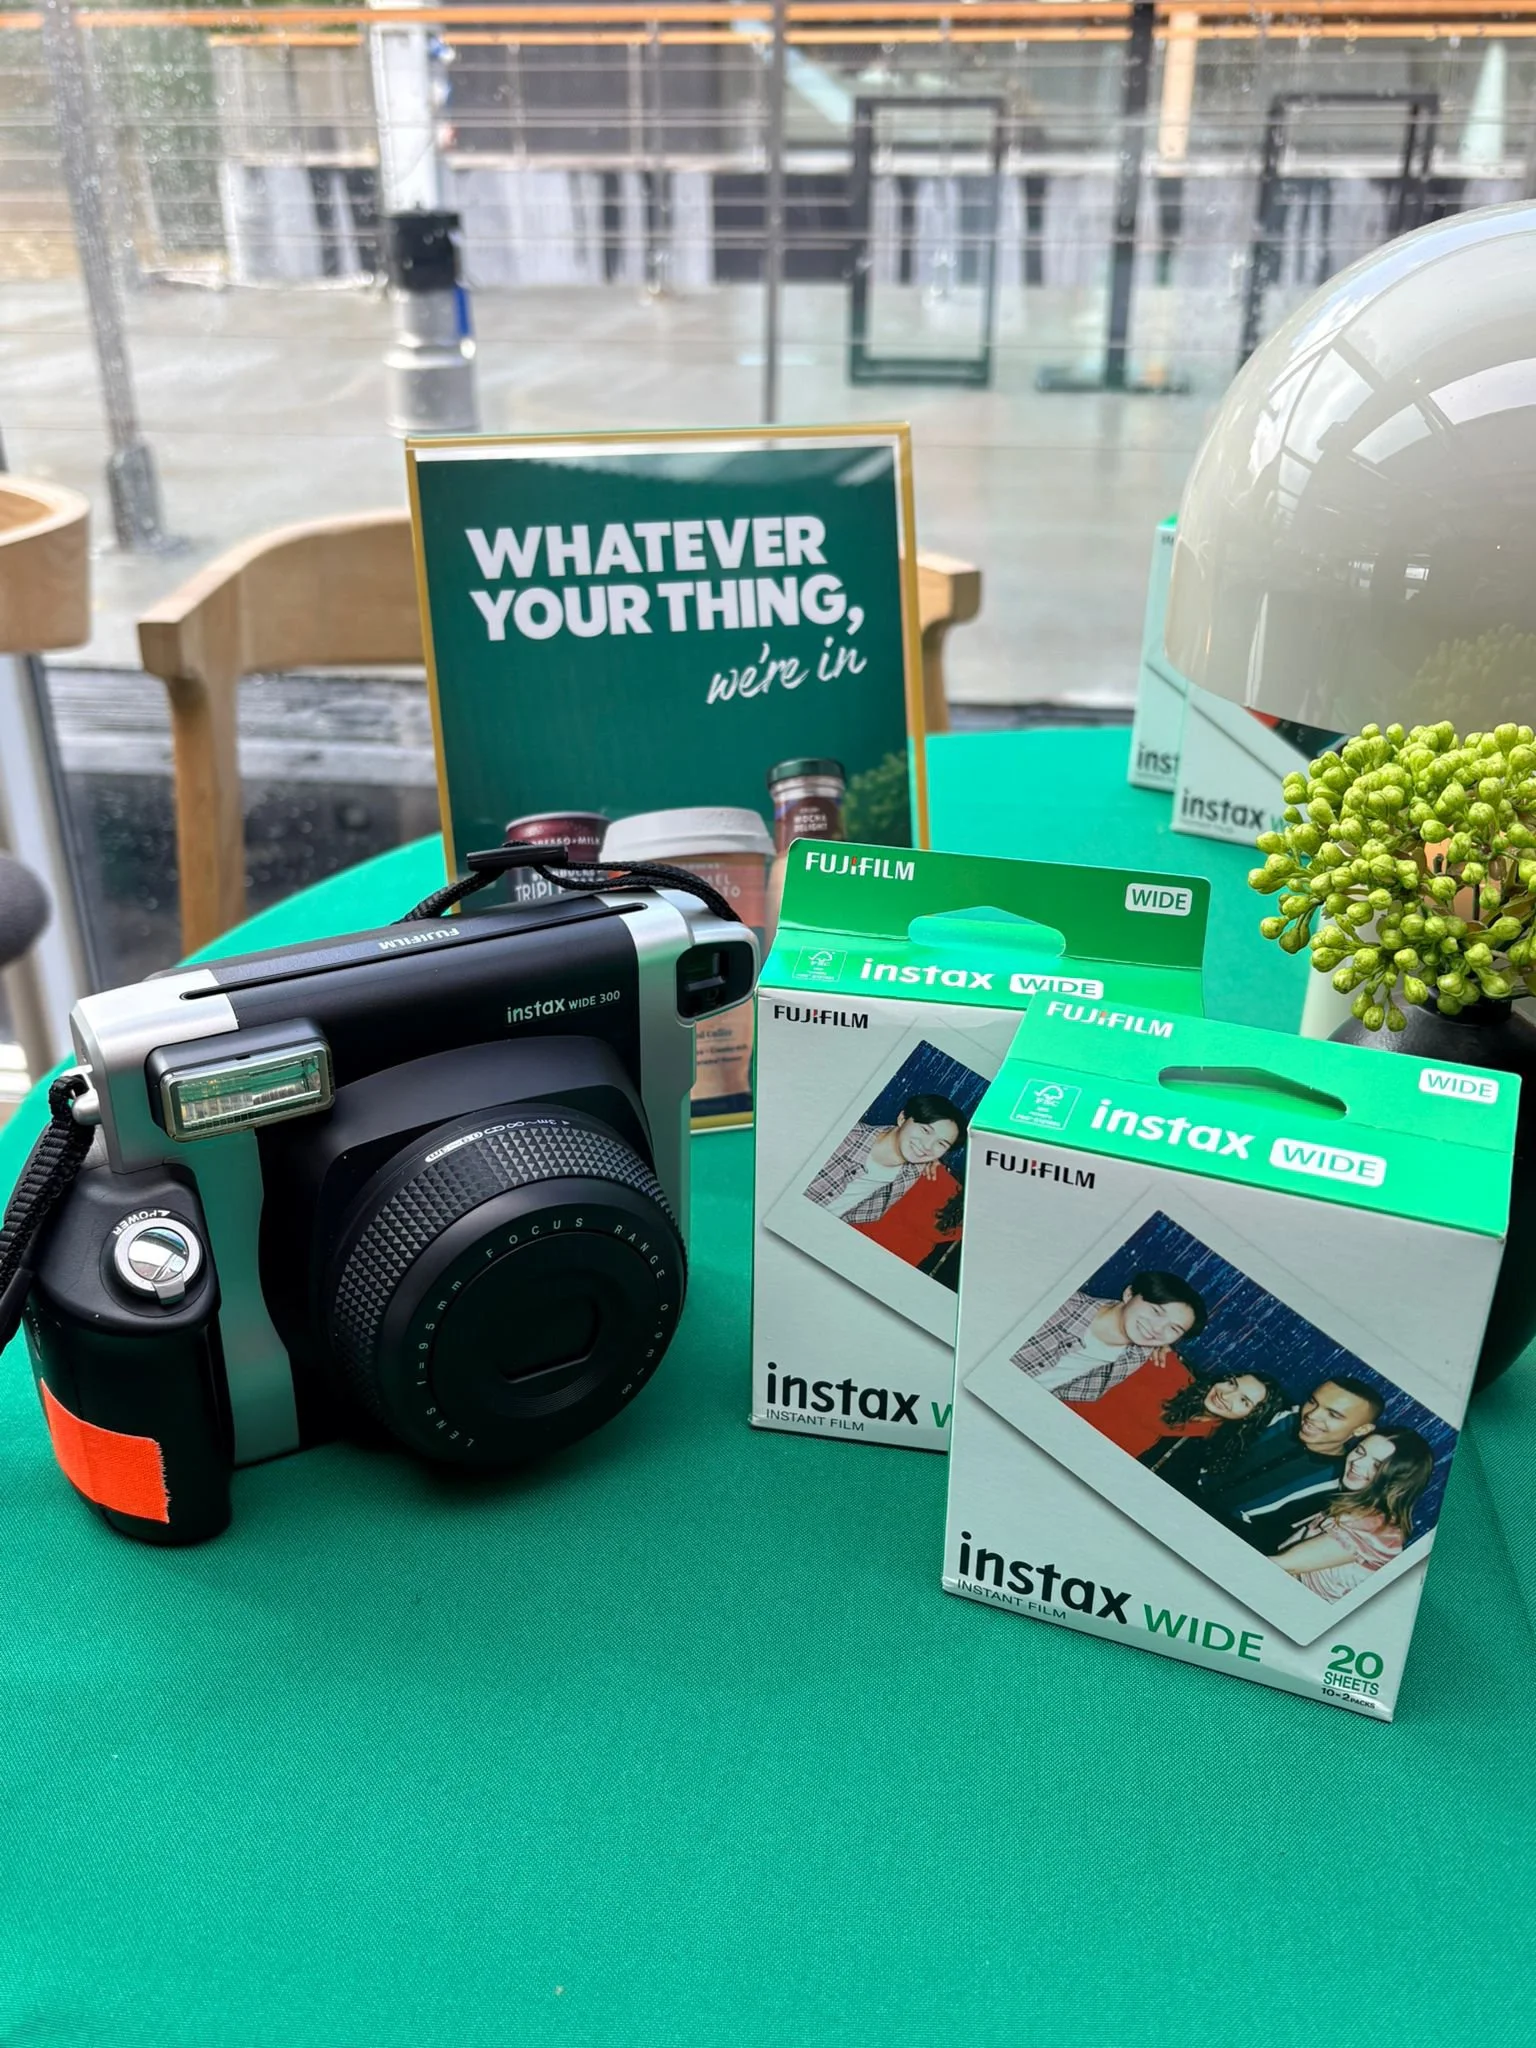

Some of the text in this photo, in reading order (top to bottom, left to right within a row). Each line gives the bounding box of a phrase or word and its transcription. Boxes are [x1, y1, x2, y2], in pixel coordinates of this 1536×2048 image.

[465, 515, 828, 580] WHATEVER
[468, 574, 866, 642] YOUR THING,
[705, 636, 868, 704] we're in
[1181, 787, 1265, 830] instax
[805, 851, 916, 881] FUJIFILM
[1131, 887, 1188, 911] WIDE
[378, 927, 461, 951] FUJIFILM
[860, 957, 996, 991] instax
[1017, 977, 1097, 996] WIDE
[507, 990, 621, 1024] instax WIDE 300
[773, 1004, 869, 1030] FUJIFILM
[1046, 1000, 1175, 1039] FUJIFILM
[1427, 1072, 1493, 1098] WIDE
[1090, 1098, 1257, 1161] instax
[1283, 1143, 1380, 1181] WIDE
[985, 1149, 1096, 1190] FUJIFILM
[112, 1209, 157, 1236] POWER
[485, 1217, 584, 1259] FOCUS
[613, 1224, 666, 1279] RANGE
[767, 1361, 921, 1426] instax
[766, 1408, 865, 1432] INSTANT FILM
[957, 1578, 1067, 1620] INSTANT FILM
[959, 1530, 1265, 1663] instax WIDE
[1327, 1644, 1384, 1680] 20
[1323, 1671, 1380, 1696] SHEETS
